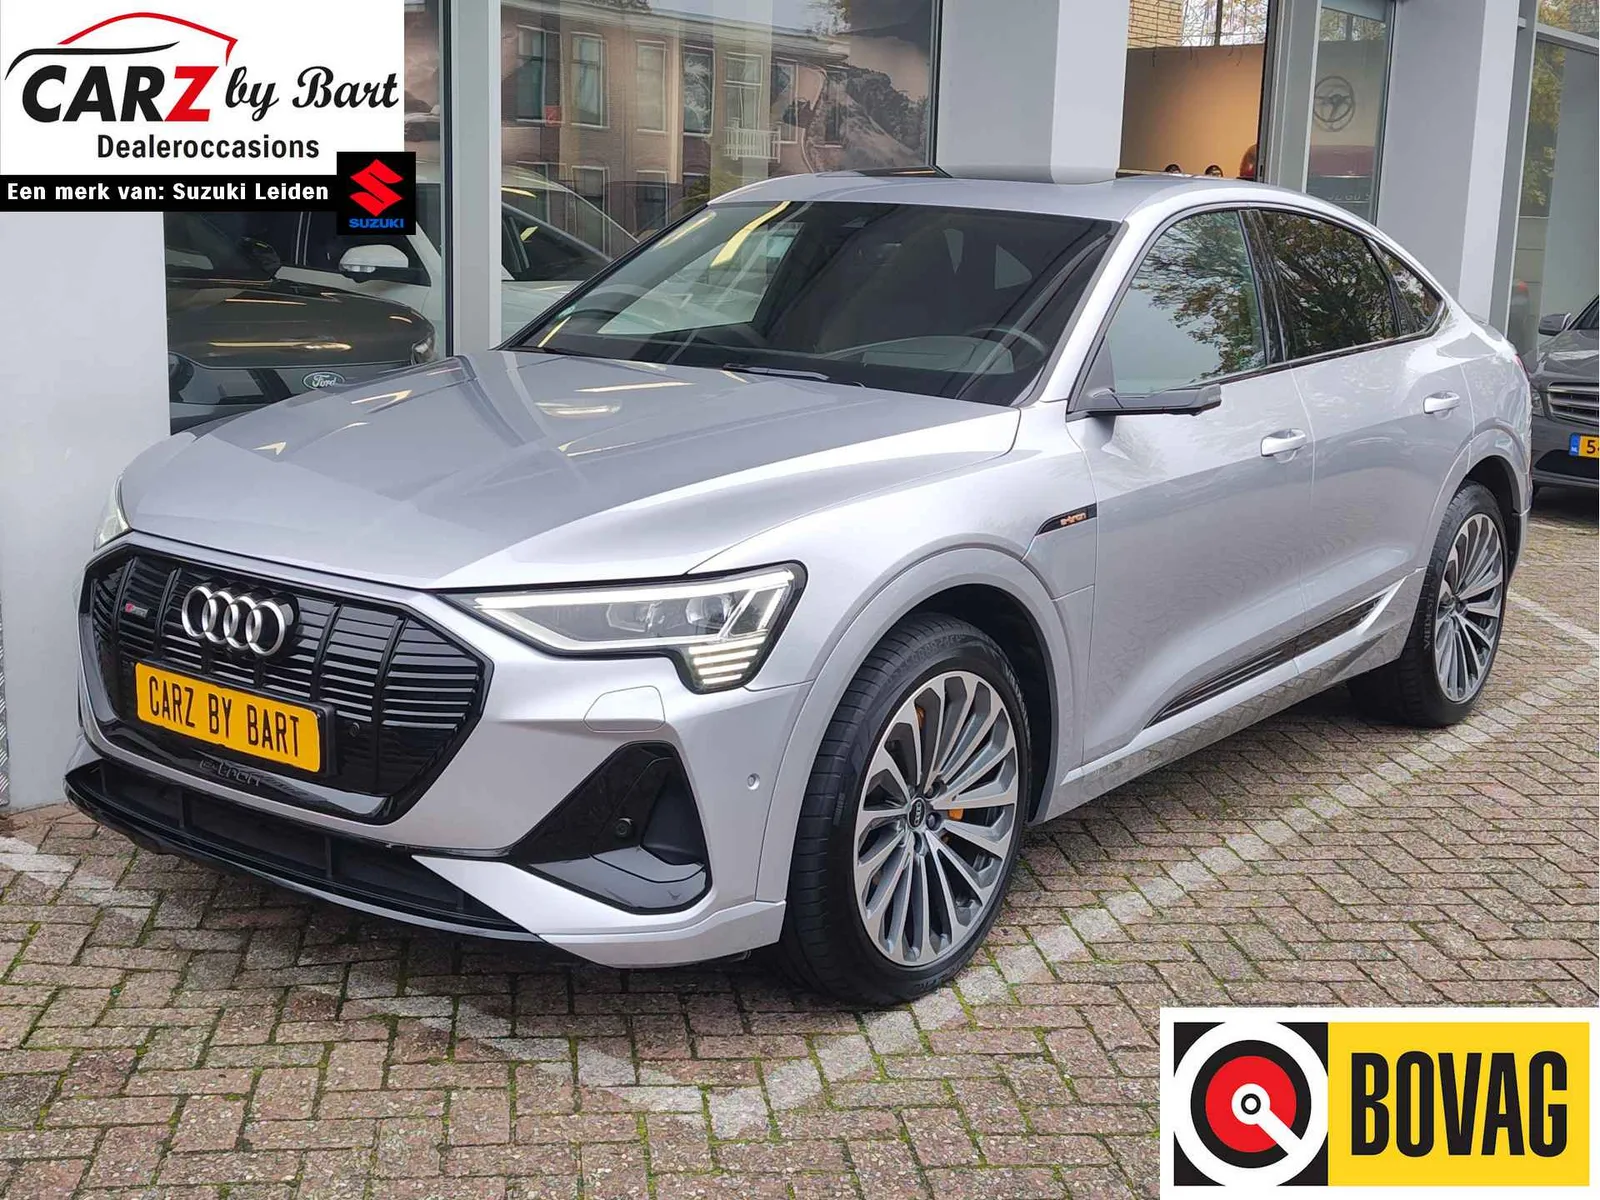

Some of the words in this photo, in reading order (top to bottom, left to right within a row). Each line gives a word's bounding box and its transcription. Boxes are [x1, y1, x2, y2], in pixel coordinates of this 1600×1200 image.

[312, 374, 337, 388] Ford
[149, 676, 196, 729] CARZ
[208, 693, 233, 738] BY
[247, 705, 300, 757] BART
